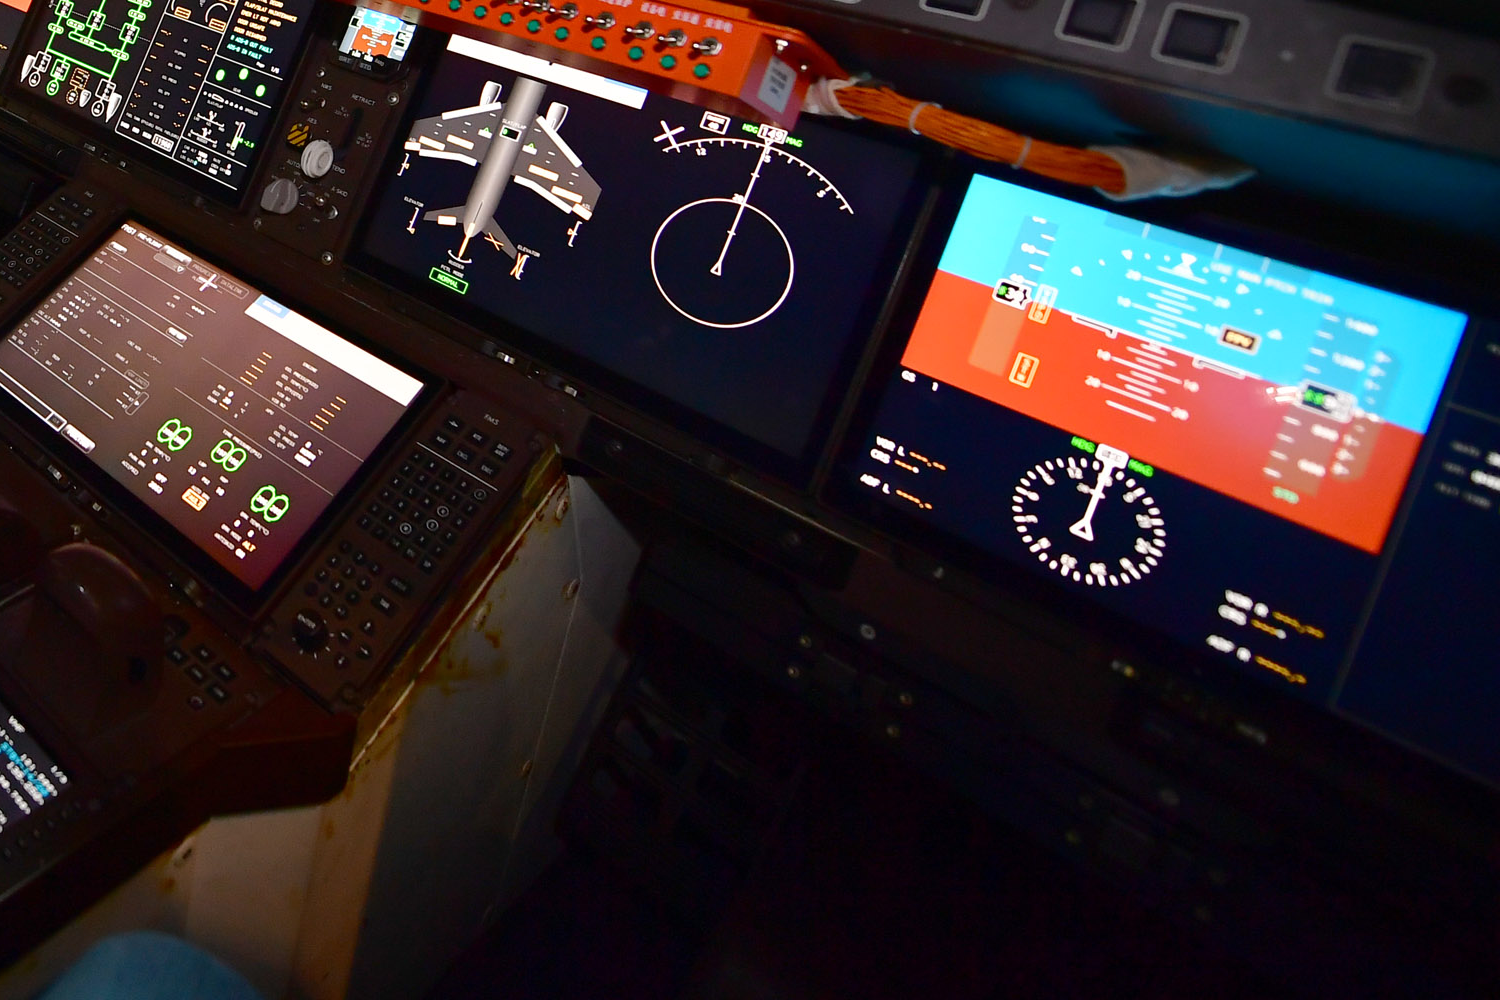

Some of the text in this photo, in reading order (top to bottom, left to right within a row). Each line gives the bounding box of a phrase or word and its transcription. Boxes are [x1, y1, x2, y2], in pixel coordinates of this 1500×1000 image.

[248, 50, 263, 60] FAULT
[259, 45, 274, 54] FAULT
[351, 93, 376, 106] RETRACT
[742, 123, 759, 134] HDG
[761, 127, 785, 141] 149
[786, 136, 803, 148] MAG
[696, 148, 707, 156] 12
[404, 196, 425, 208] ELEVATOR
[517, 244, 541, 258] ELEVATOR
[448, 259, 465, 270] RUDDER
[437, 274, 458, 289] NORMAL
[1125, 269, 1142, 281] 20
[1117, 295, 1132, 308] 10
[1096, 349, 1112, 362] 10
[1085, 375, 1101, 389] 20
[1171, 407, 1189, 421] 20
[876, 435, 896, 452] VOR
[870, 448, 891, 464] CRS
[1070, 435, 1154, 478] HDG MAG
[860, 473, 881, 488] ADF
[241, 540, 257, 553] ALT
[1225, 589, 1254, 611] VOR
[1218, 604, 1247, 626] CRS
[1205, 634, 1236, 654] ADF
